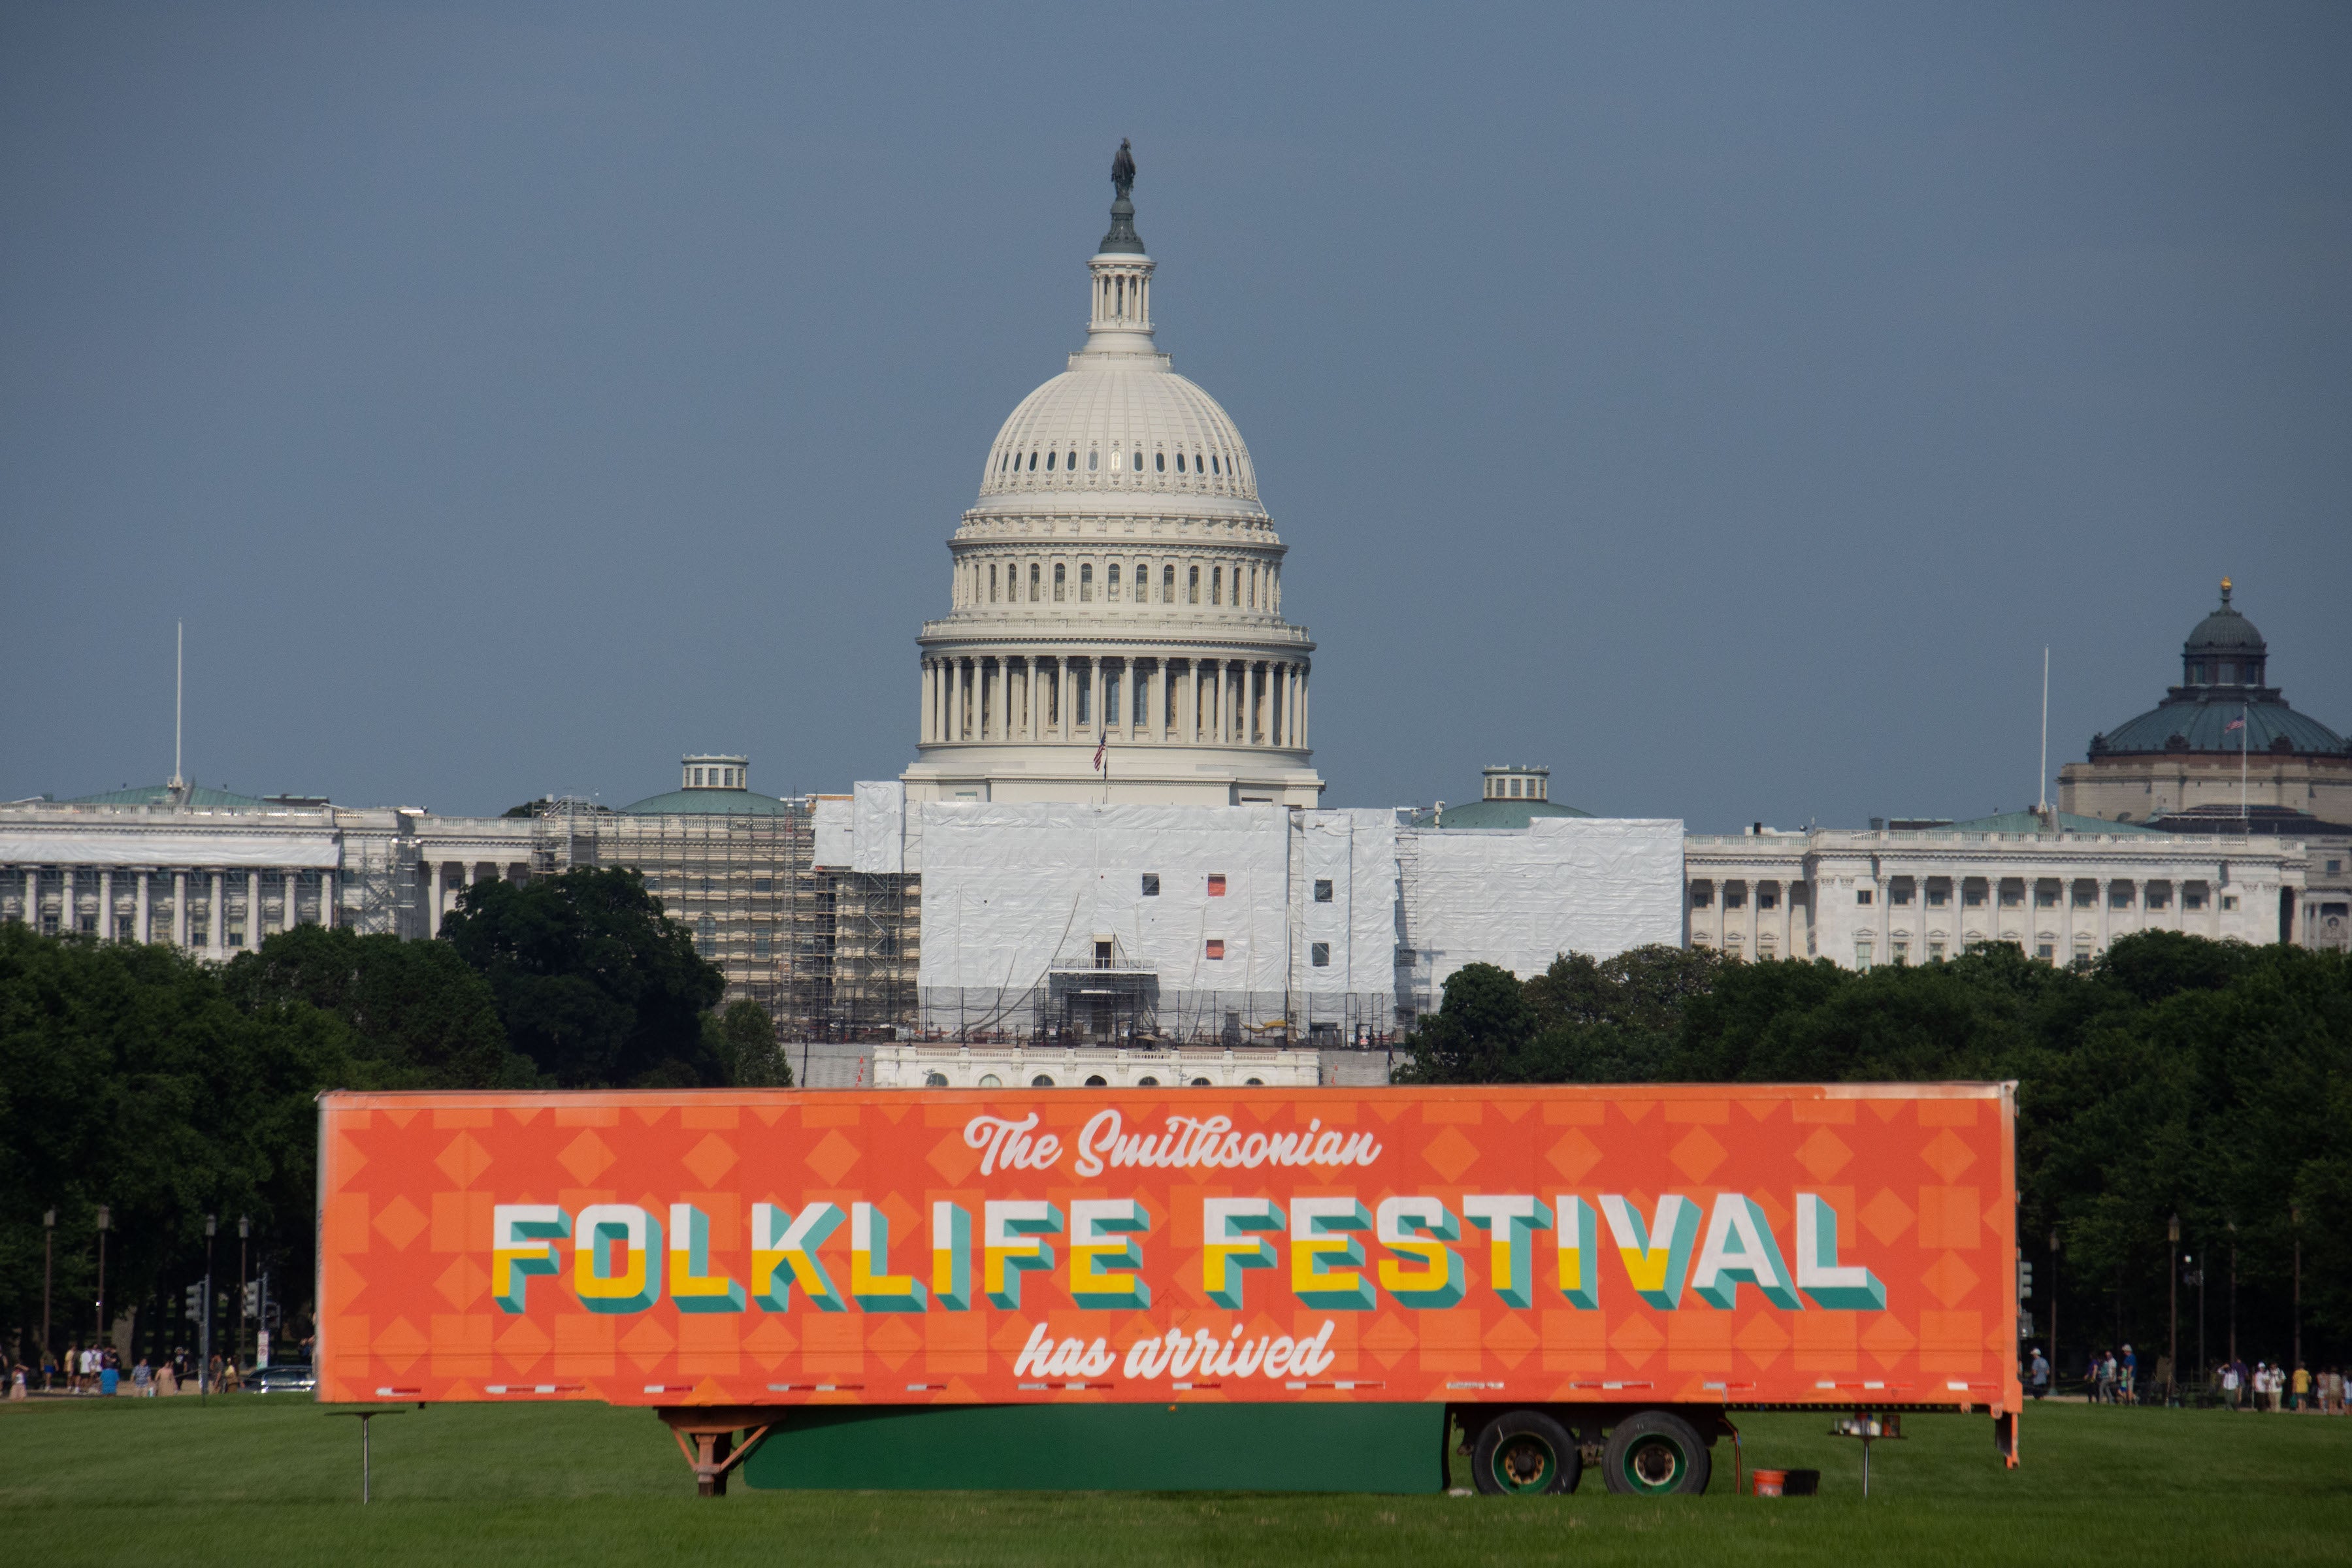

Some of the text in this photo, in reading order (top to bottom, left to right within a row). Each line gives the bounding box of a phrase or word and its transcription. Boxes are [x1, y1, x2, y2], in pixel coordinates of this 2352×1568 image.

[964, 1109, 1382, 1177] The Smithsonian
[493, 1193, 1887, 1314] FOLKLIFE FESTIVAL
[1013, 1320, 1335, 1379] has arrived
